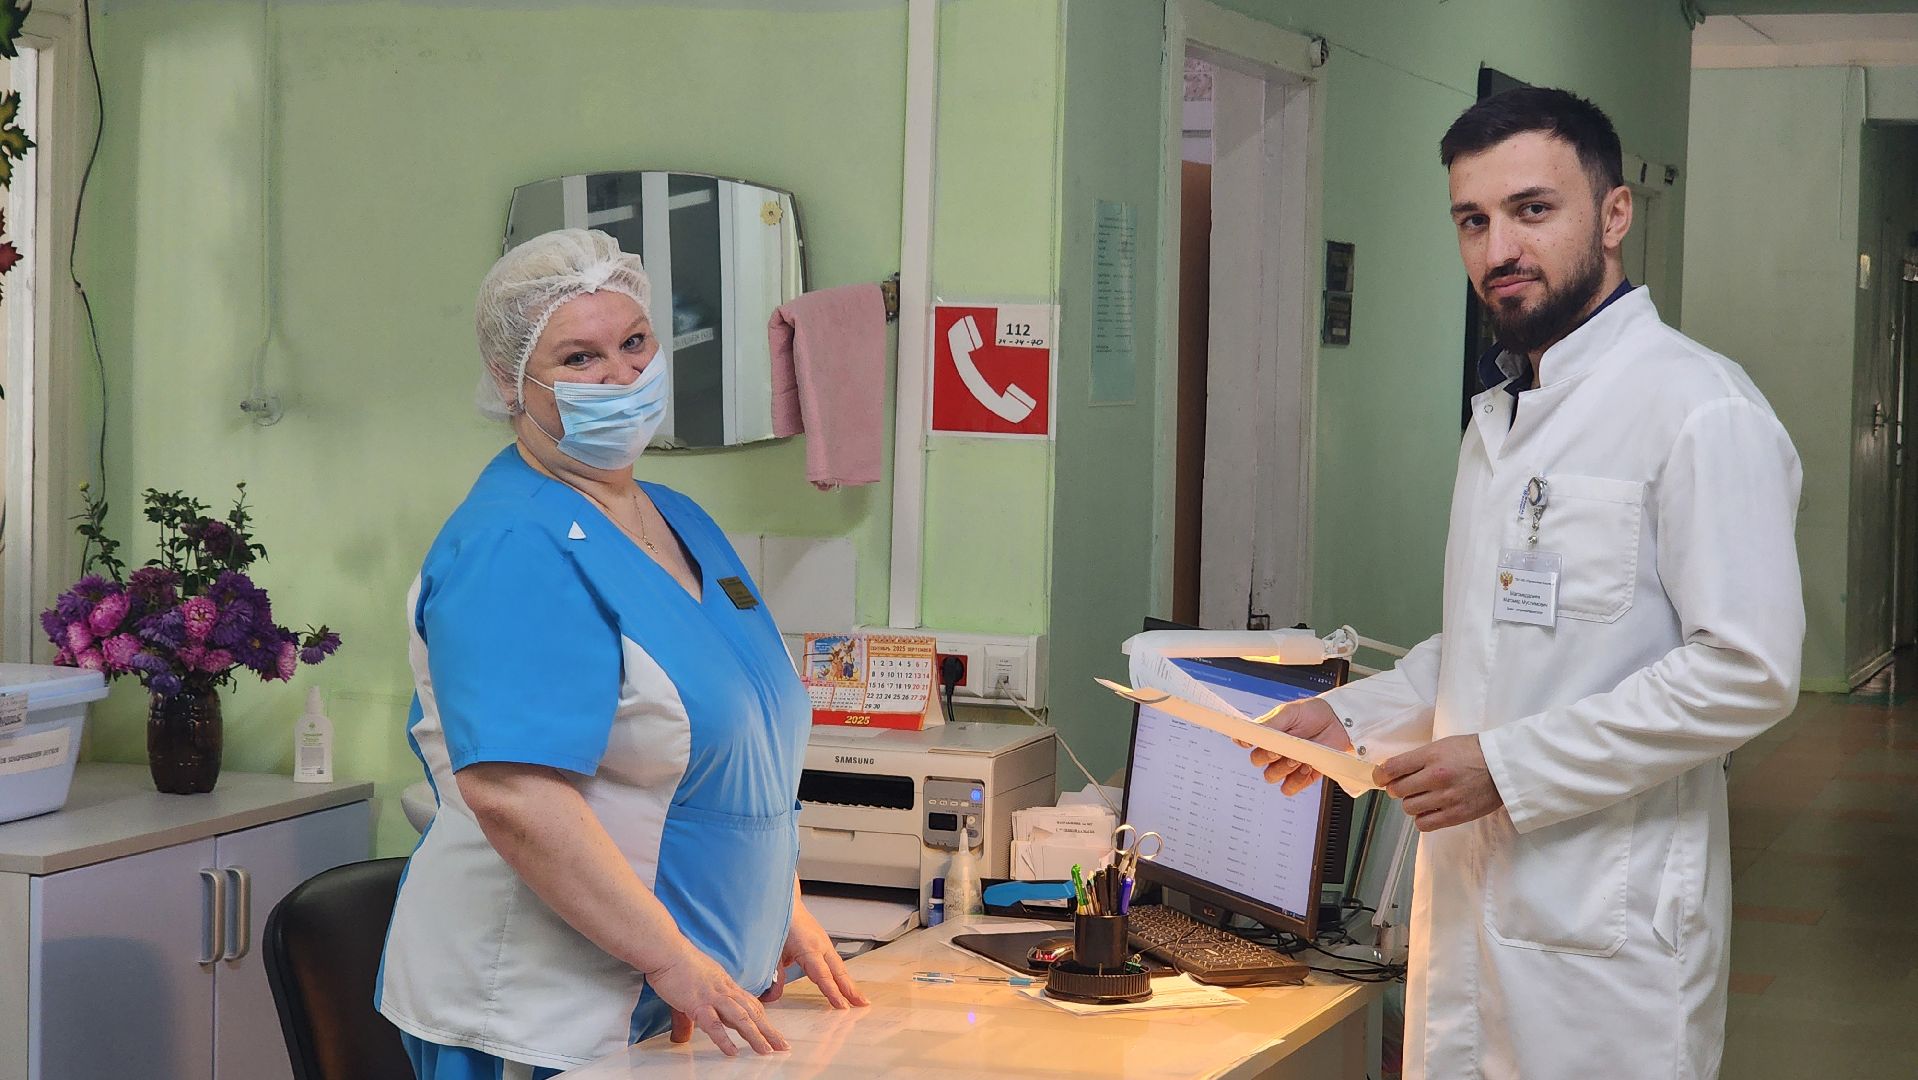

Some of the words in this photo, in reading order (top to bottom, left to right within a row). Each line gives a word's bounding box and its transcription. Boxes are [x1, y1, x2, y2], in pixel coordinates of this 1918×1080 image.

[1006, 323, 1031, 336] 112
[845, 715, 871, 725] 2025
[834, 755, 875, 765] SAMSUNG
